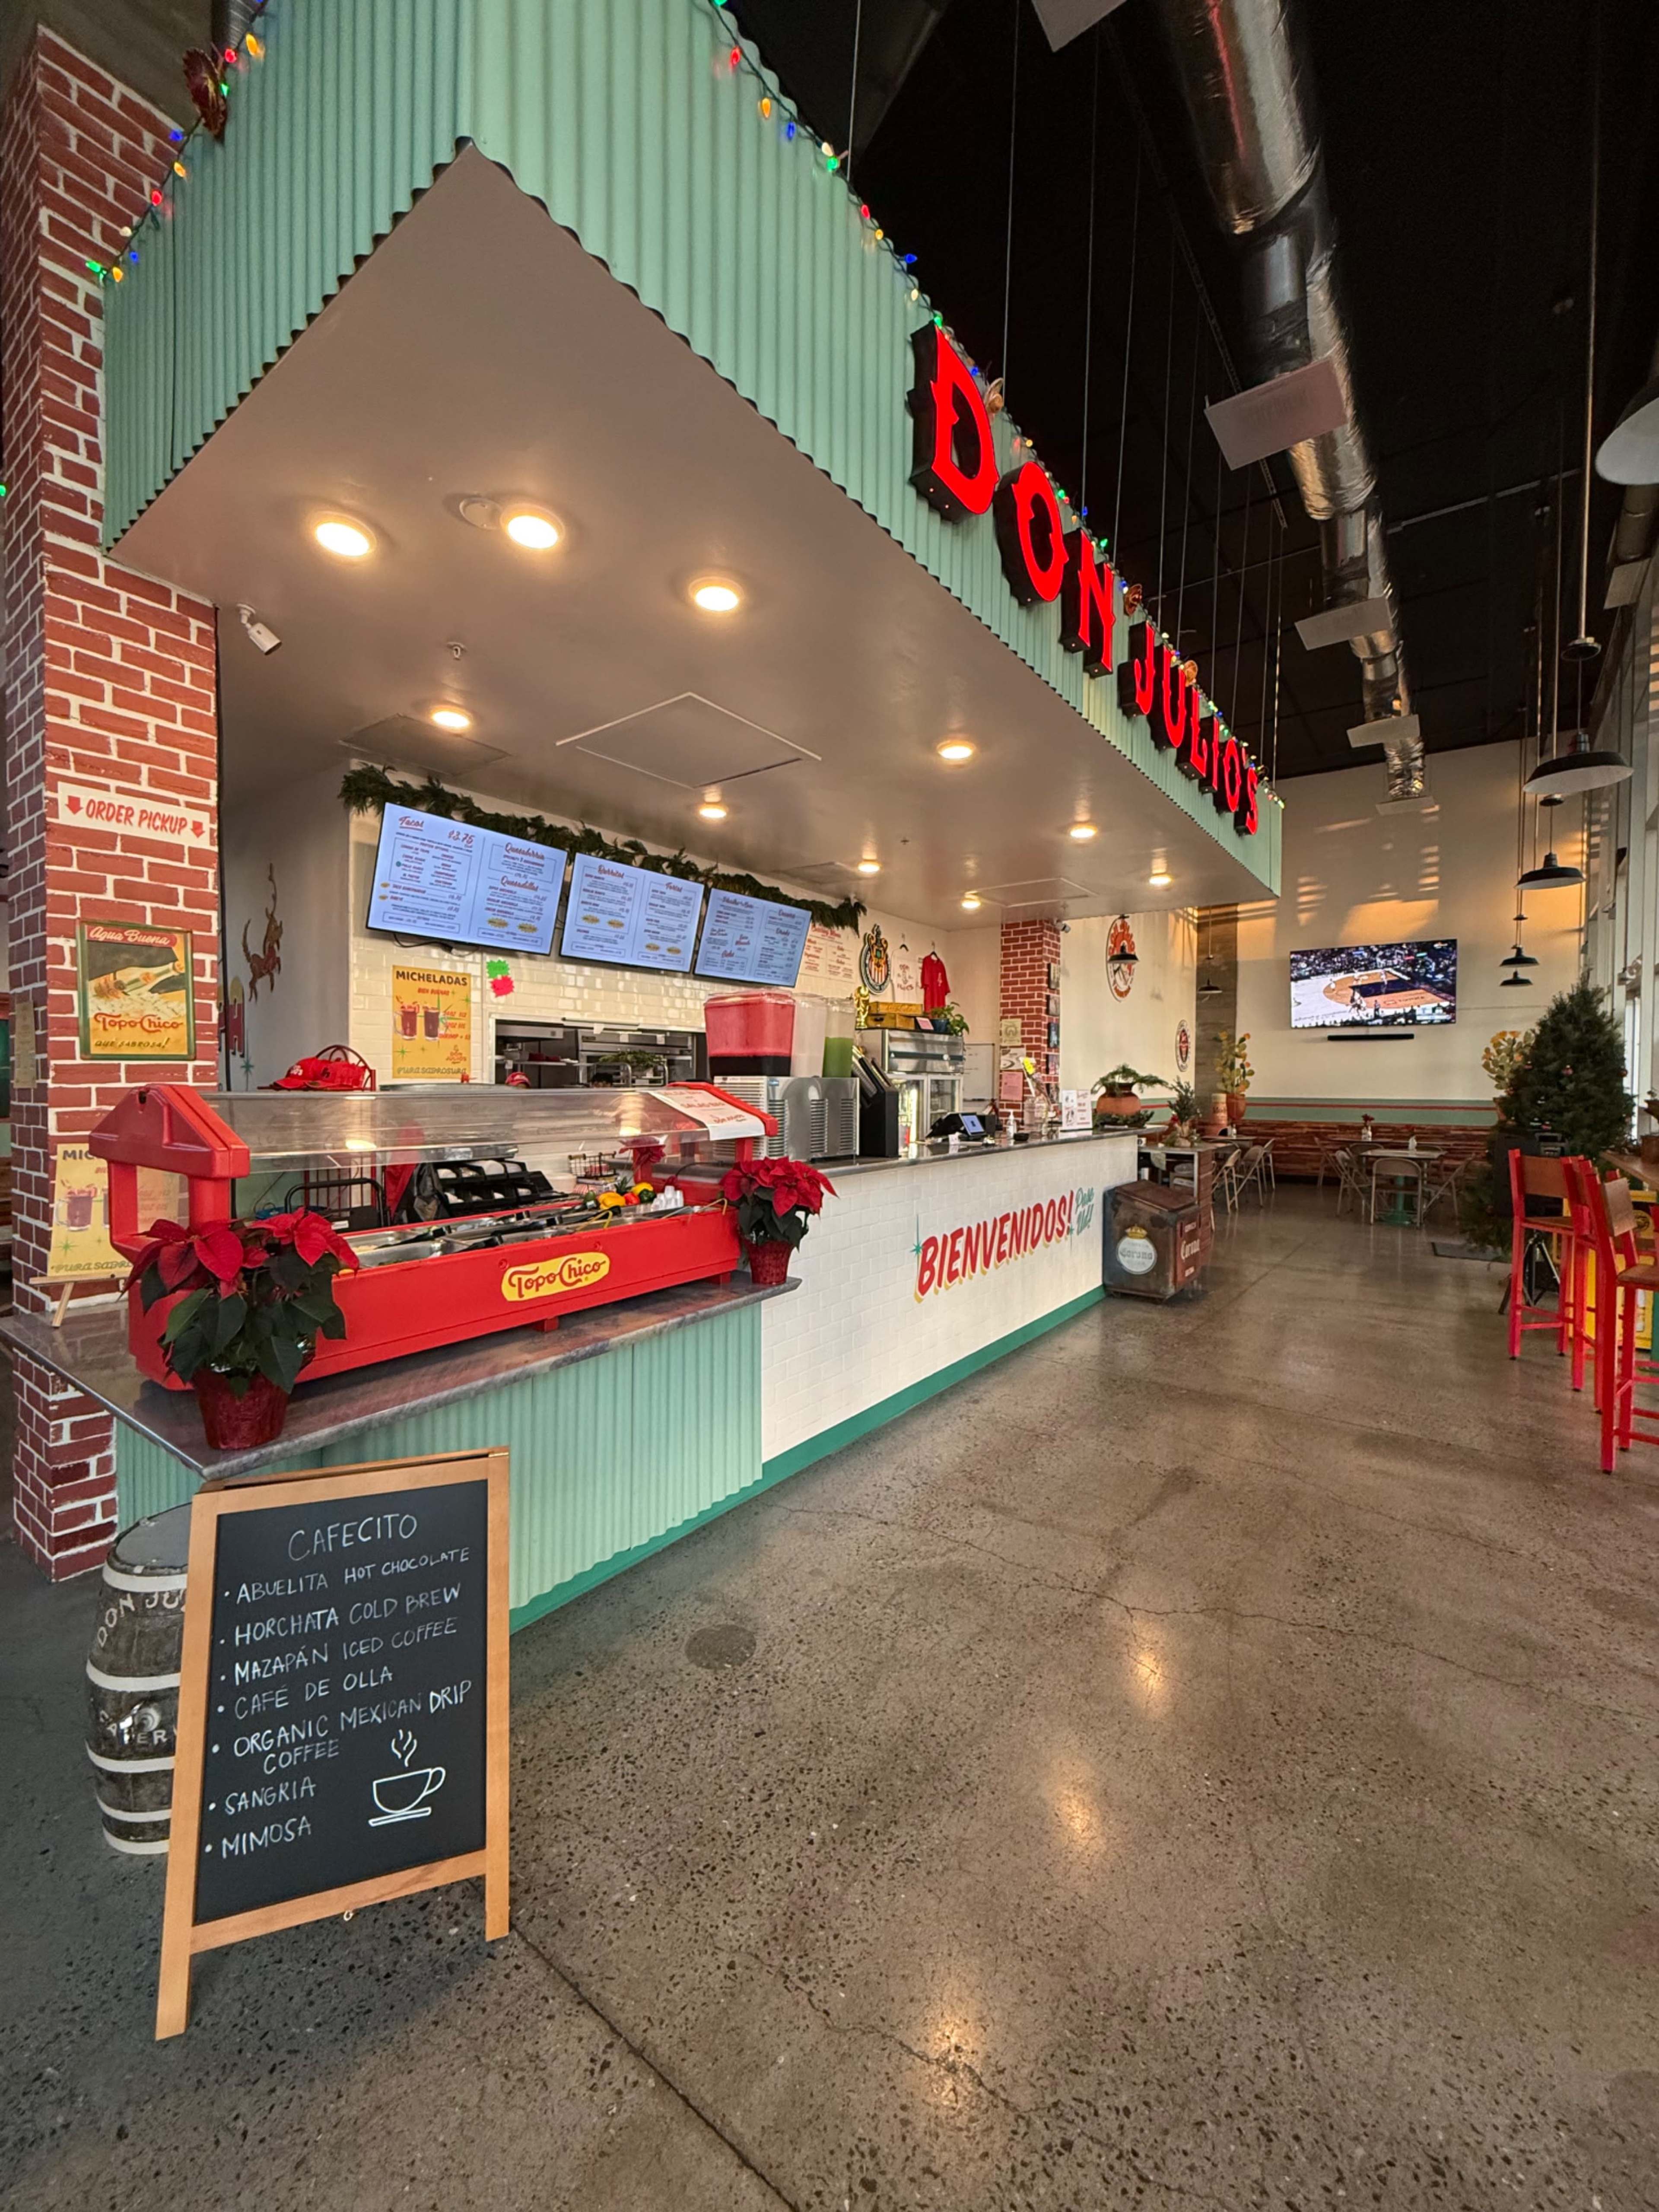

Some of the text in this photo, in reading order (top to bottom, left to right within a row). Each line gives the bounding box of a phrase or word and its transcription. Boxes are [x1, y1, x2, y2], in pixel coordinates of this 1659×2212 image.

[913, 321, 1259, 836] DON JULIO'S
[86, 799, 188, 836] ORDER PICKUP
[398, 816, 424, 828] Tacos
[89, 926, 170, 945] Agua Buena
[396, 970, 467, 986] MICHELADAS
[94, 1012, 183, 1033] Topo Chico
[914, 1190, 1074, 1303] BIENVENIDOS!
[1120, 1248, 1152, 1259] Corona
[1181, 1239, 1200, 1262] Corona
[509, 1257, 606, 1298] Topo Chico
[287, 1513, 419, 1561] CAFECITO
[236, 1547, 471, 1605] ABUELITA HOT CHOCOLATE
[97, 1593, 135, 1648] DON
[234, 1582, 461, 1647] HORCHATA COLD BREW
[234, 1617, 458, 1686] MAZAPÁN ICED COFFEE
[234, 1665, 393, 1720] CAFÉ DE OLLA
[234, 1679, 473, 1758] ORGANIC MEXICAN DRIP
[264, 1738, 340, 1775] COFFEE
[225, 1778, 318, 1815] SANGRIA
[222, 1816, 312, 1859] MIMOSA
